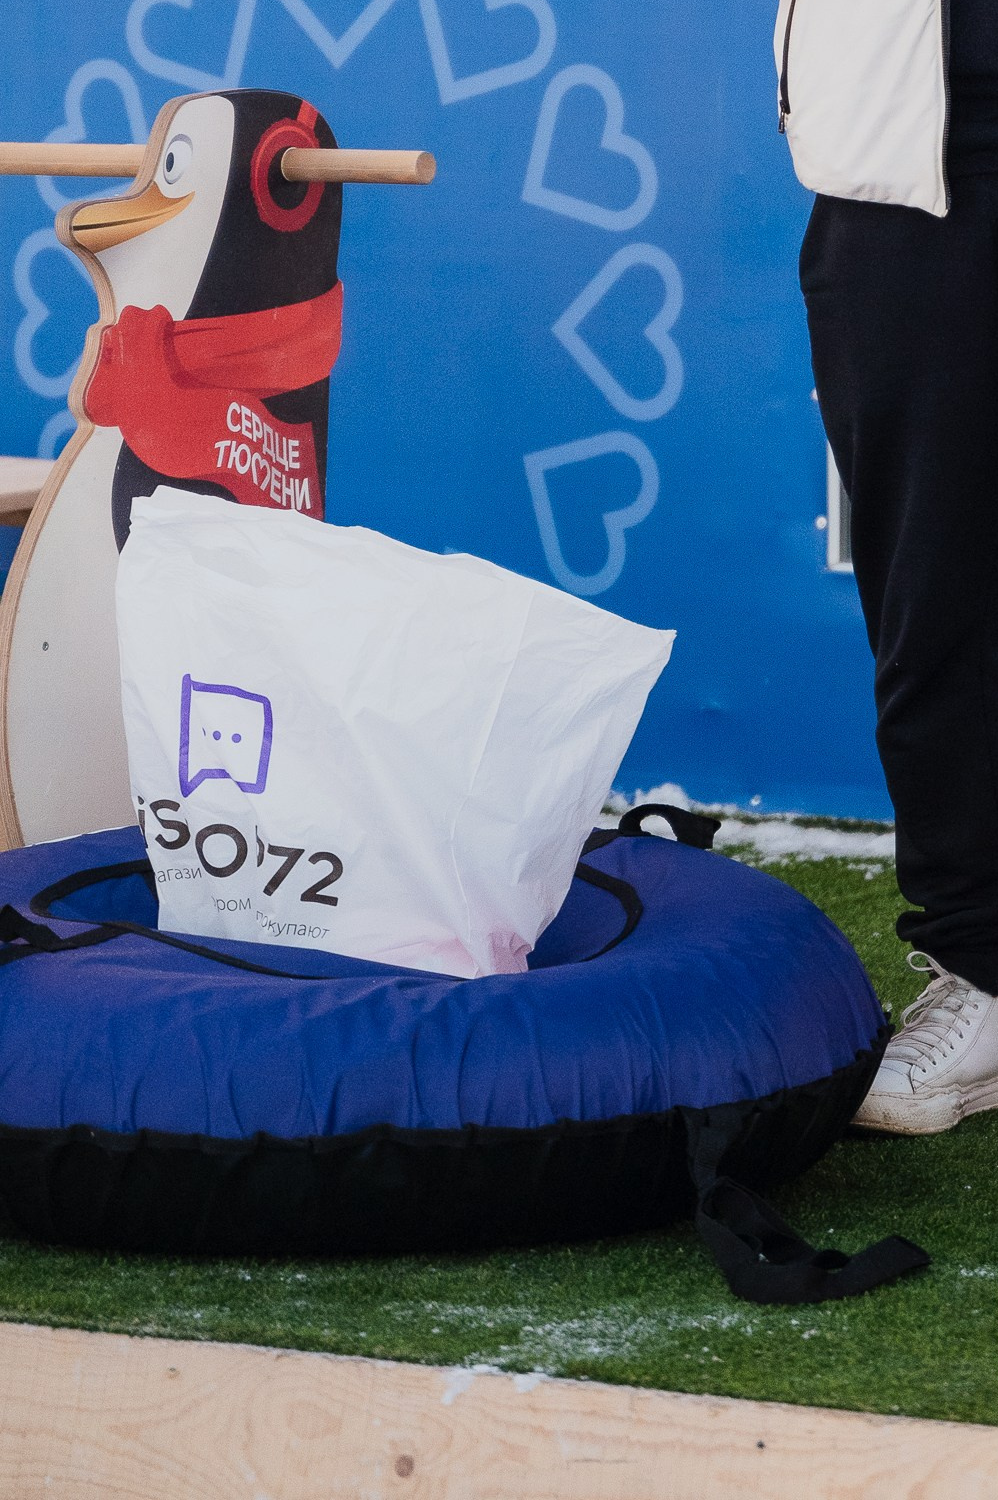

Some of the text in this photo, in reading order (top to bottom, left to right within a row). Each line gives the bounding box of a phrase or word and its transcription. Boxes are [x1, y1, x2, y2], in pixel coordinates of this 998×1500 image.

[226, 401, 300, 472] СЕРДЦЕ
[138, 795, 344, 907] iSO72
[156, 867, 202, 884] агази
[256, 910, 330, 939] покупают
